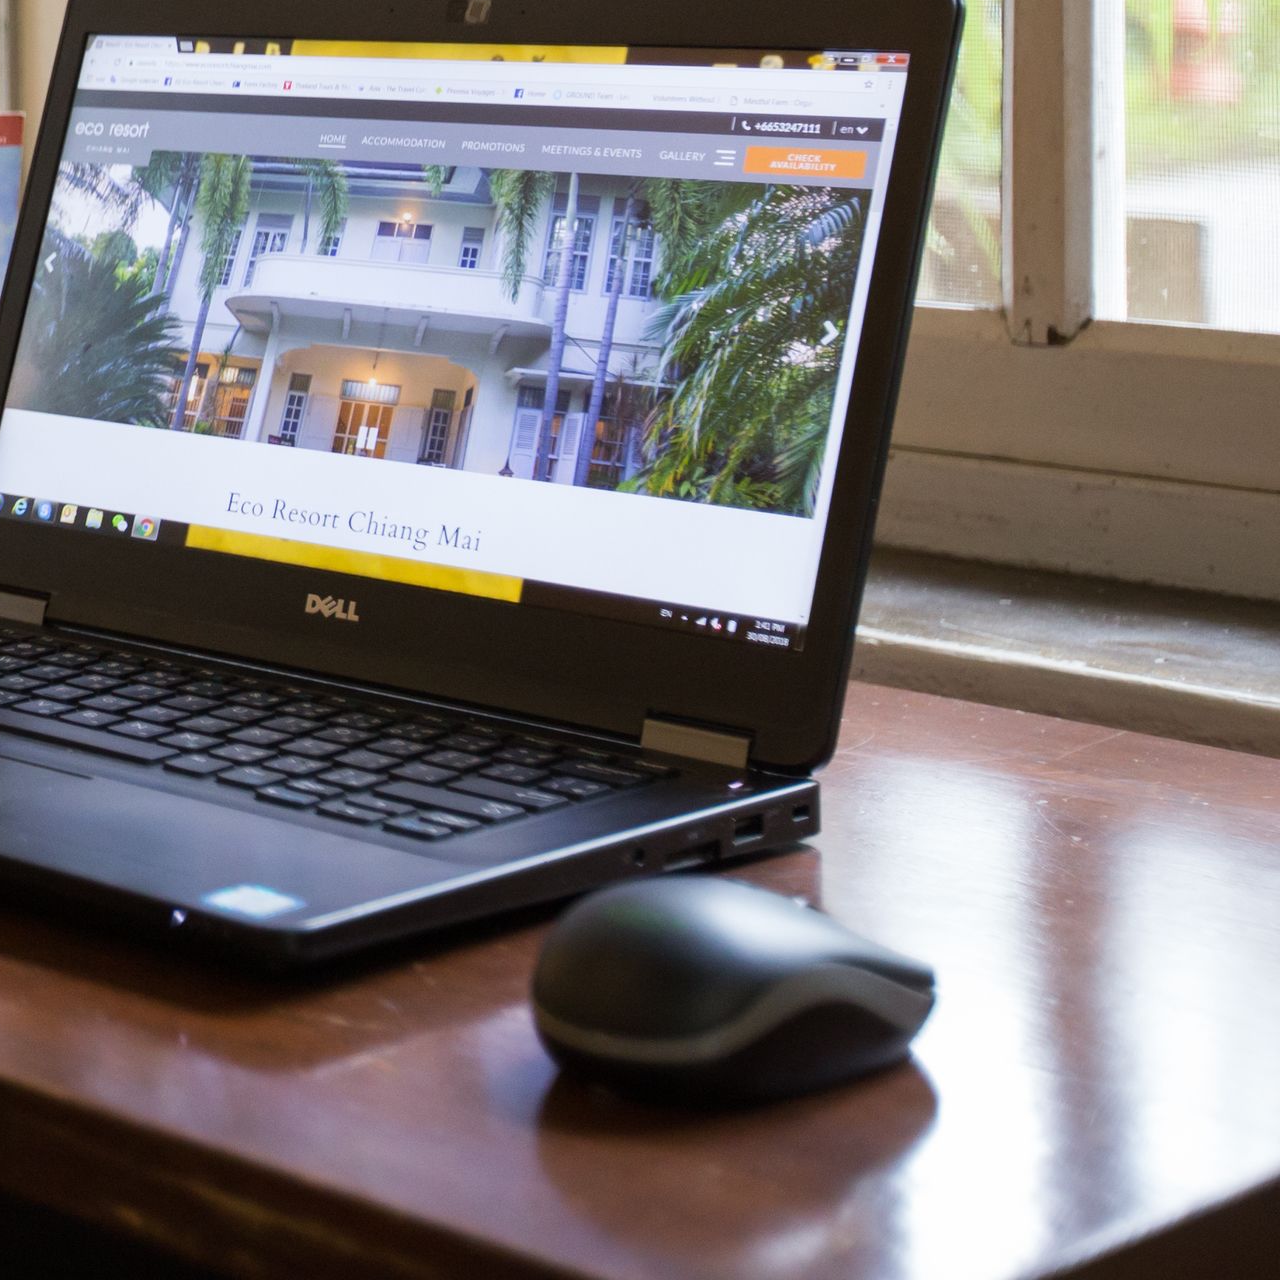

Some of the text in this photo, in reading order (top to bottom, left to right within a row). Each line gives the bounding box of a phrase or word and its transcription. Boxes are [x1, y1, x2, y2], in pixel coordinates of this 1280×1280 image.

[75, 122, 150, 138] eco resort
[839, 125, 854, 134] en
[319, 133, 348, 144] HOME
[361, 135, 446, 149] ACCOMMODATION
[461, 140, 526, 153] PROMOTIONS
[542, 144, 643, 159] MEETINGS & EVENTS
[659, 150, 707, 162] GALLERY
[787, 152, 822, 163] CHECK
[769, 159, 837, 172] AVAILABILITY
[227, 491, 483, 552] Eco Resort Chiang Mai
[305, 593, 360, 622] DELL
[659, 607, 673, 618] EN
